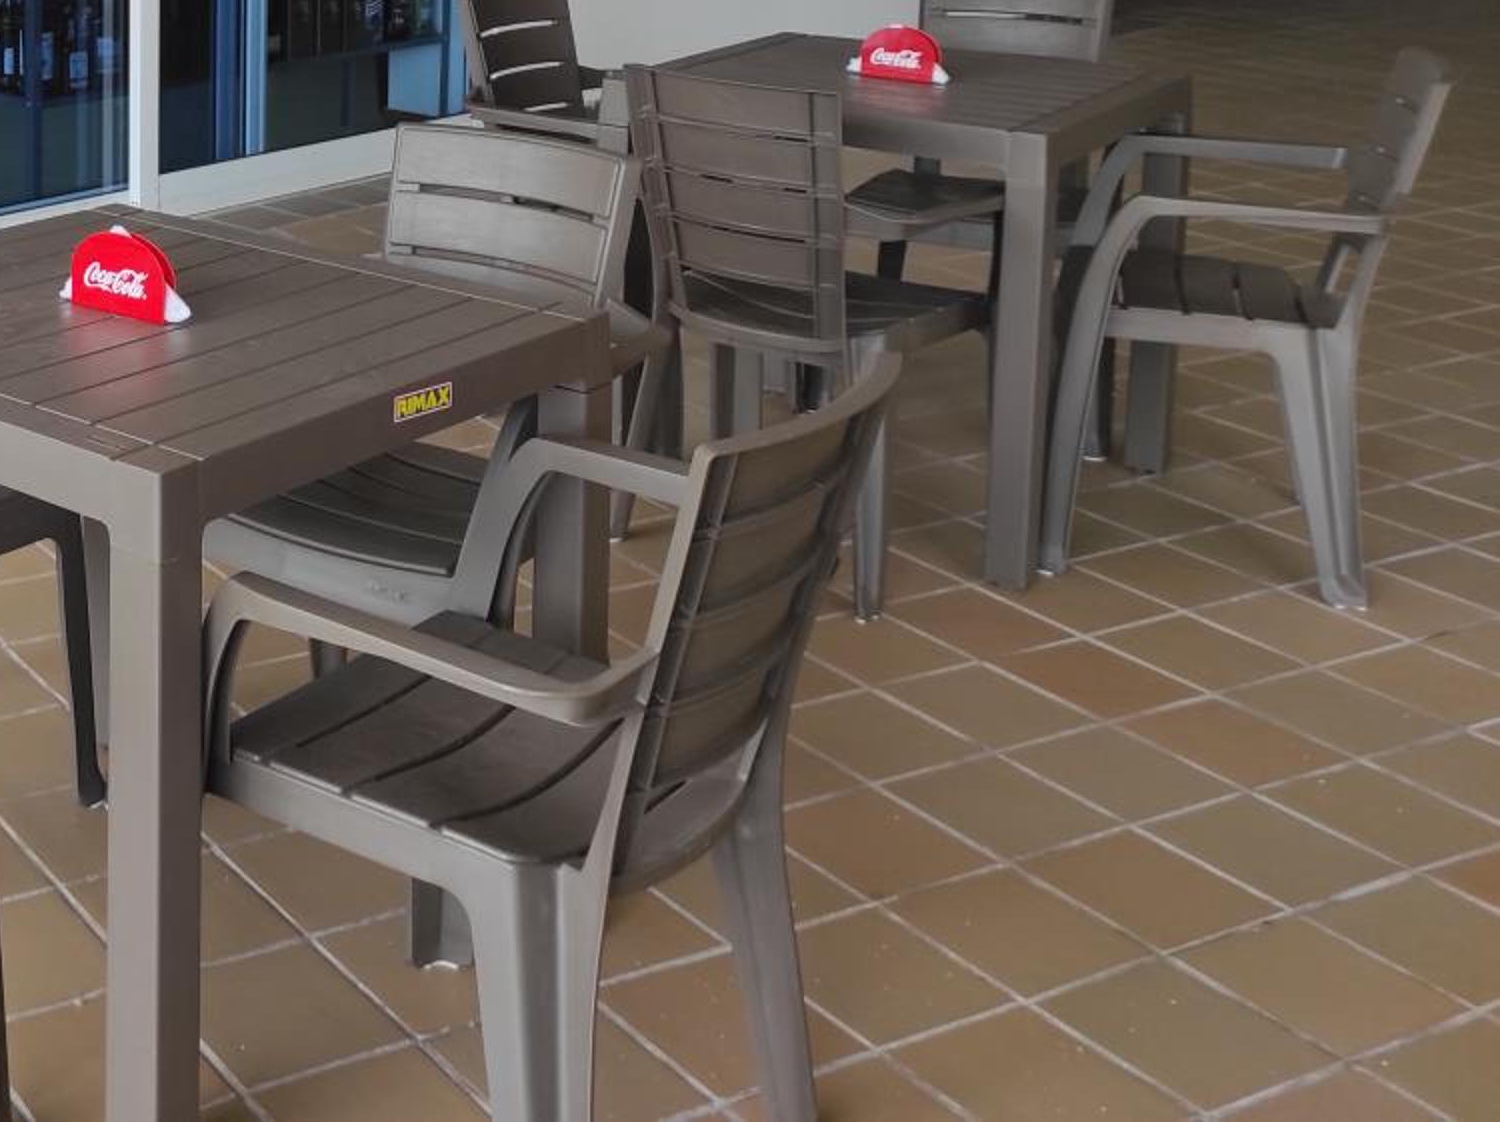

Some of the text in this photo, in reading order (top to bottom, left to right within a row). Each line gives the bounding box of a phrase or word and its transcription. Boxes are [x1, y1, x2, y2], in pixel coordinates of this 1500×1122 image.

[870, 47, 923, 69] Coca-Cola
[83, 261, 148, 299] Coca-Cola
[398, 386, 449, 417] RIMAX
